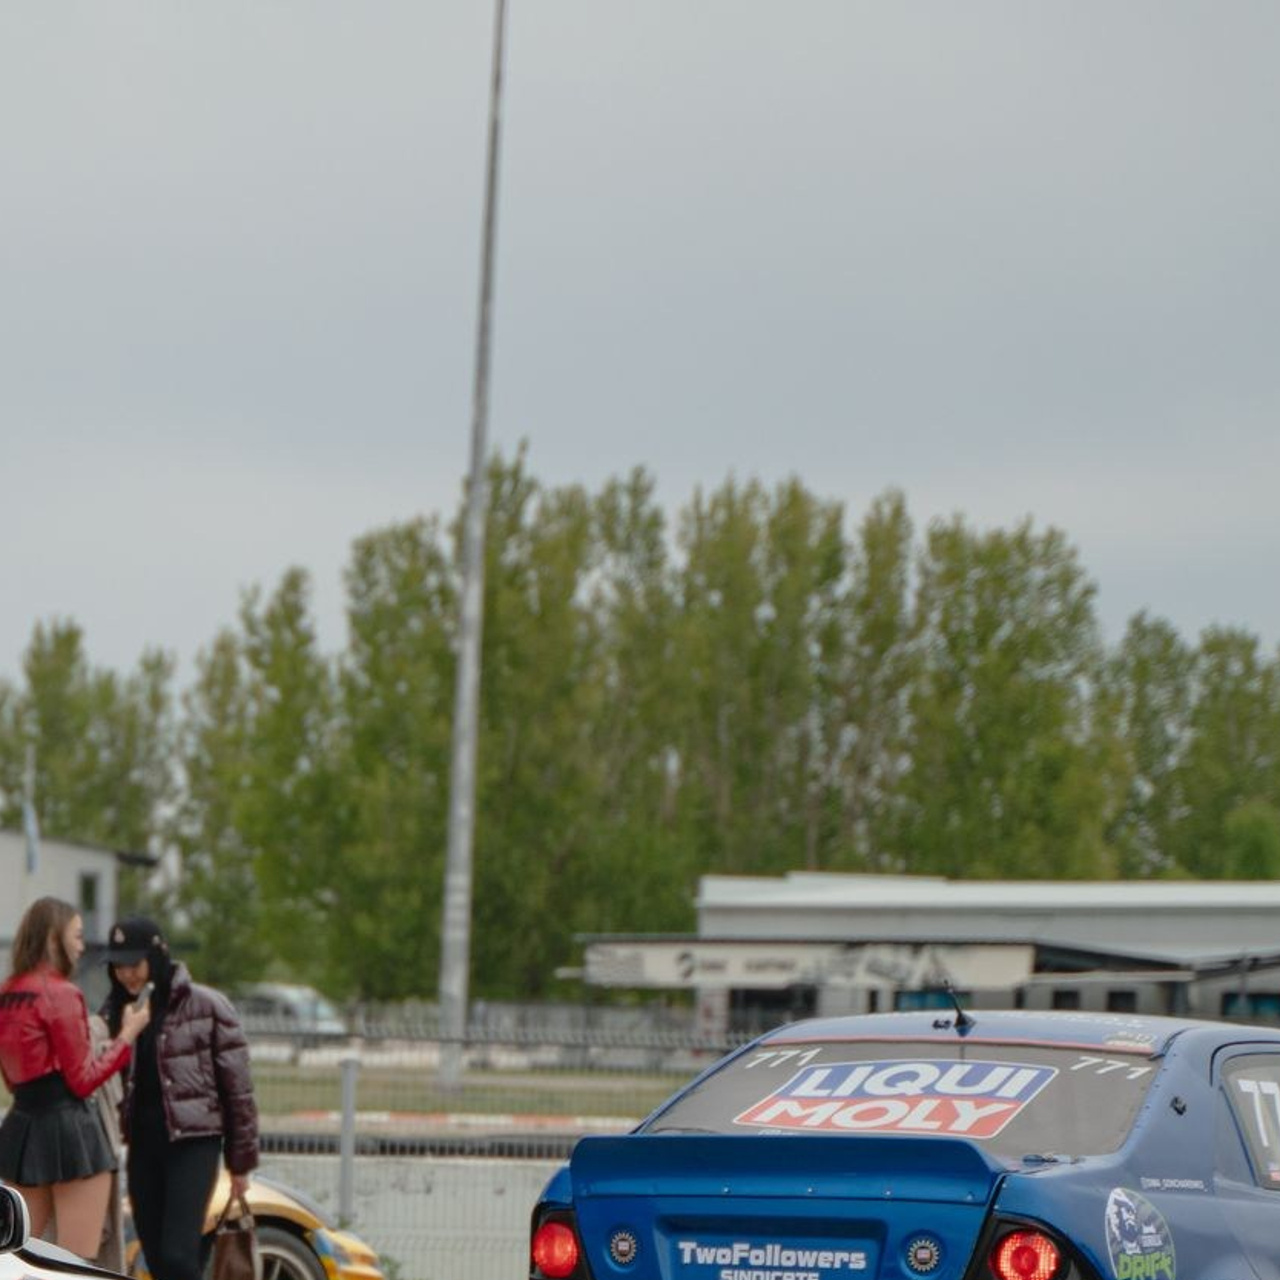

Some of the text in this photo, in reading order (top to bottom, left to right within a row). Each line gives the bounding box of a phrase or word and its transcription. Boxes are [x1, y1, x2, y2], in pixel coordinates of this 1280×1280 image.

[745, 1047, 823, 1070] 771
[1069, 1056, 1152, 1080] 771
[789, 1063, 1039, 1099] LIQUI
[760, 1099, 1019, 1132] MOLY
[678, 1241, 867, 1270] TwoFollowers
